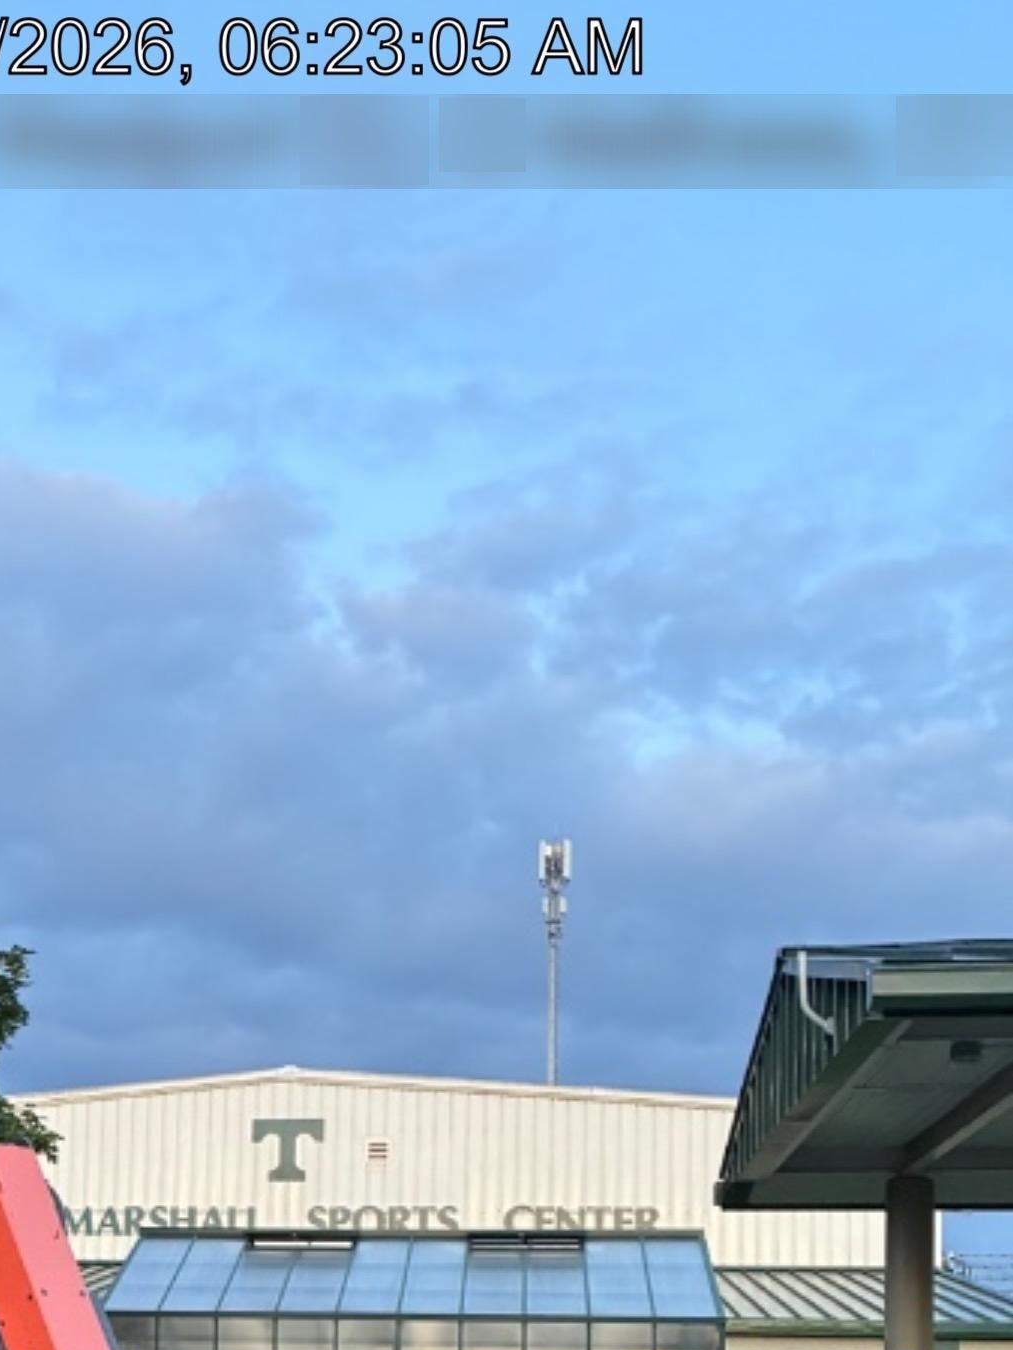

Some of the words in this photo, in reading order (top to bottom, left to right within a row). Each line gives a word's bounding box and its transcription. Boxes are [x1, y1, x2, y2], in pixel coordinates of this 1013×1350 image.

[252, 1118, 324, 1182] T
[307, 1205, 459, 1230] SPORTS
[503, 1205, 660, 1230] CENTER
